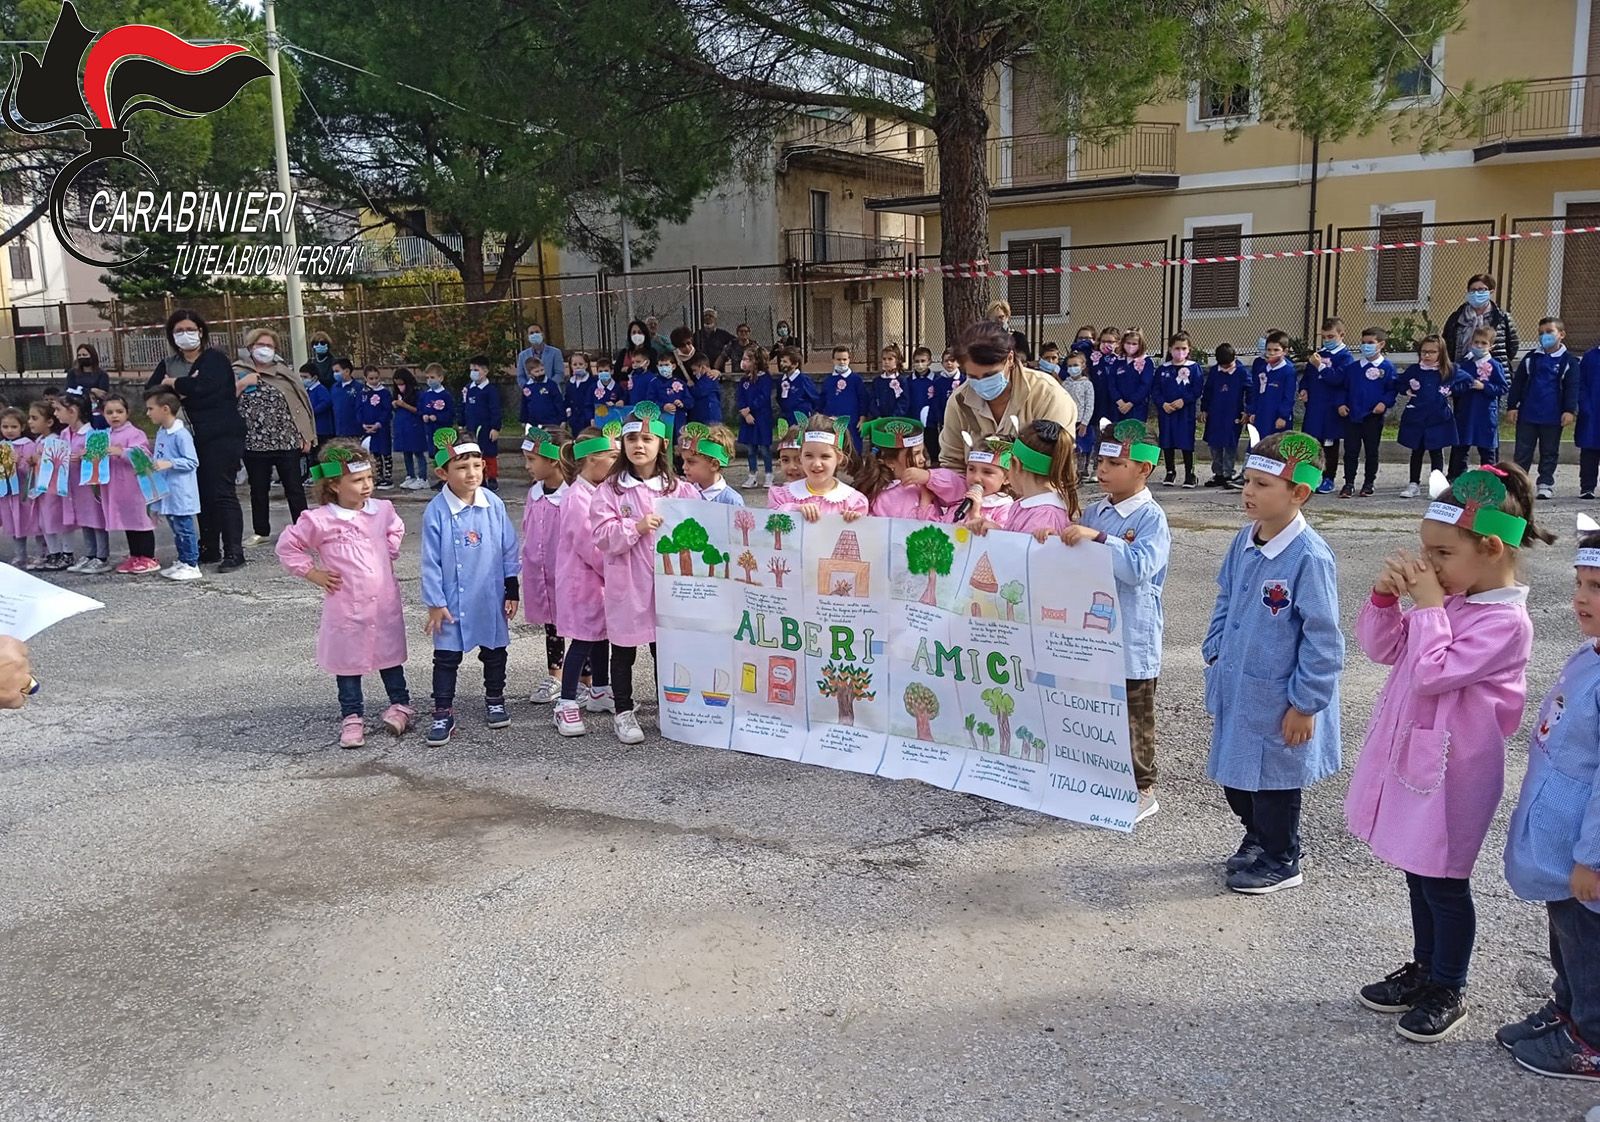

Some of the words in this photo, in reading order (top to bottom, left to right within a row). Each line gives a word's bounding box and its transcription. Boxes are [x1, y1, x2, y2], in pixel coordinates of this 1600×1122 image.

[733, 610, 875, 664] ALBERI
[911, 636, 1025, 692] AMICI
[1062, 717, 1117, 746] SCUOLA
